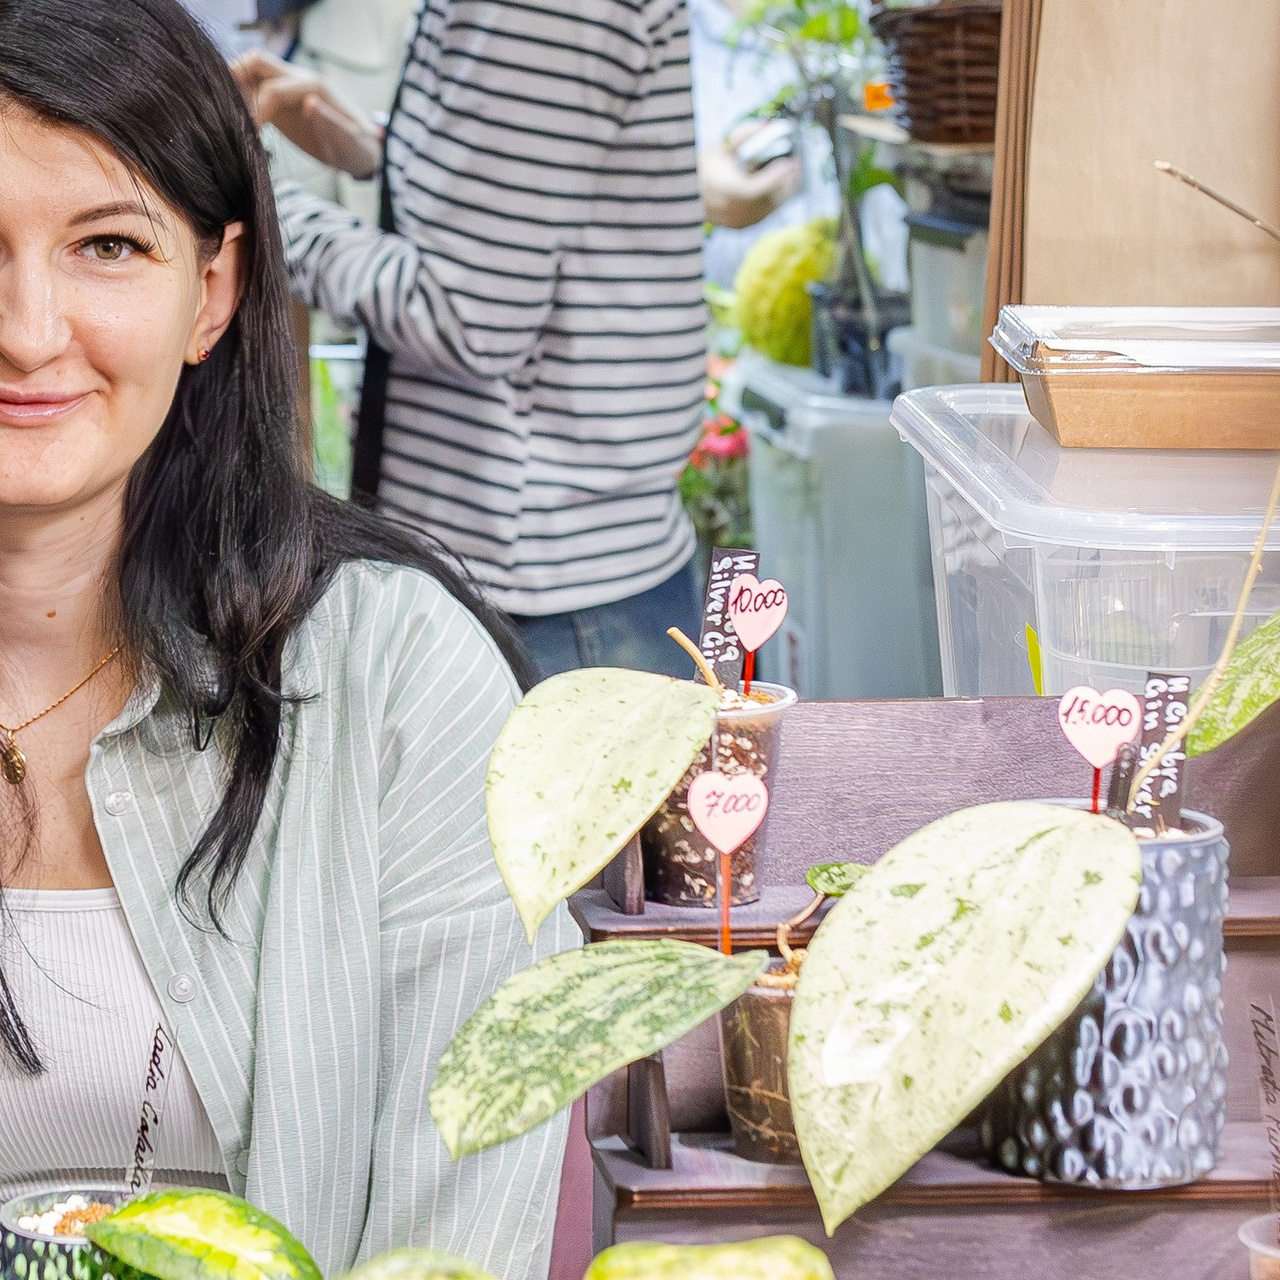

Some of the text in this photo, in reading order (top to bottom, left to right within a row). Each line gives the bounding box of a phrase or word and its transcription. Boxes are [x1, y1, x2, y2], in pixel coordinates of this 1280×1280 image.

[706, 556, 733, 626] Silver
[731, 586, 785, 615] 10.000
[1143, 678, 1168, 731] Gin
